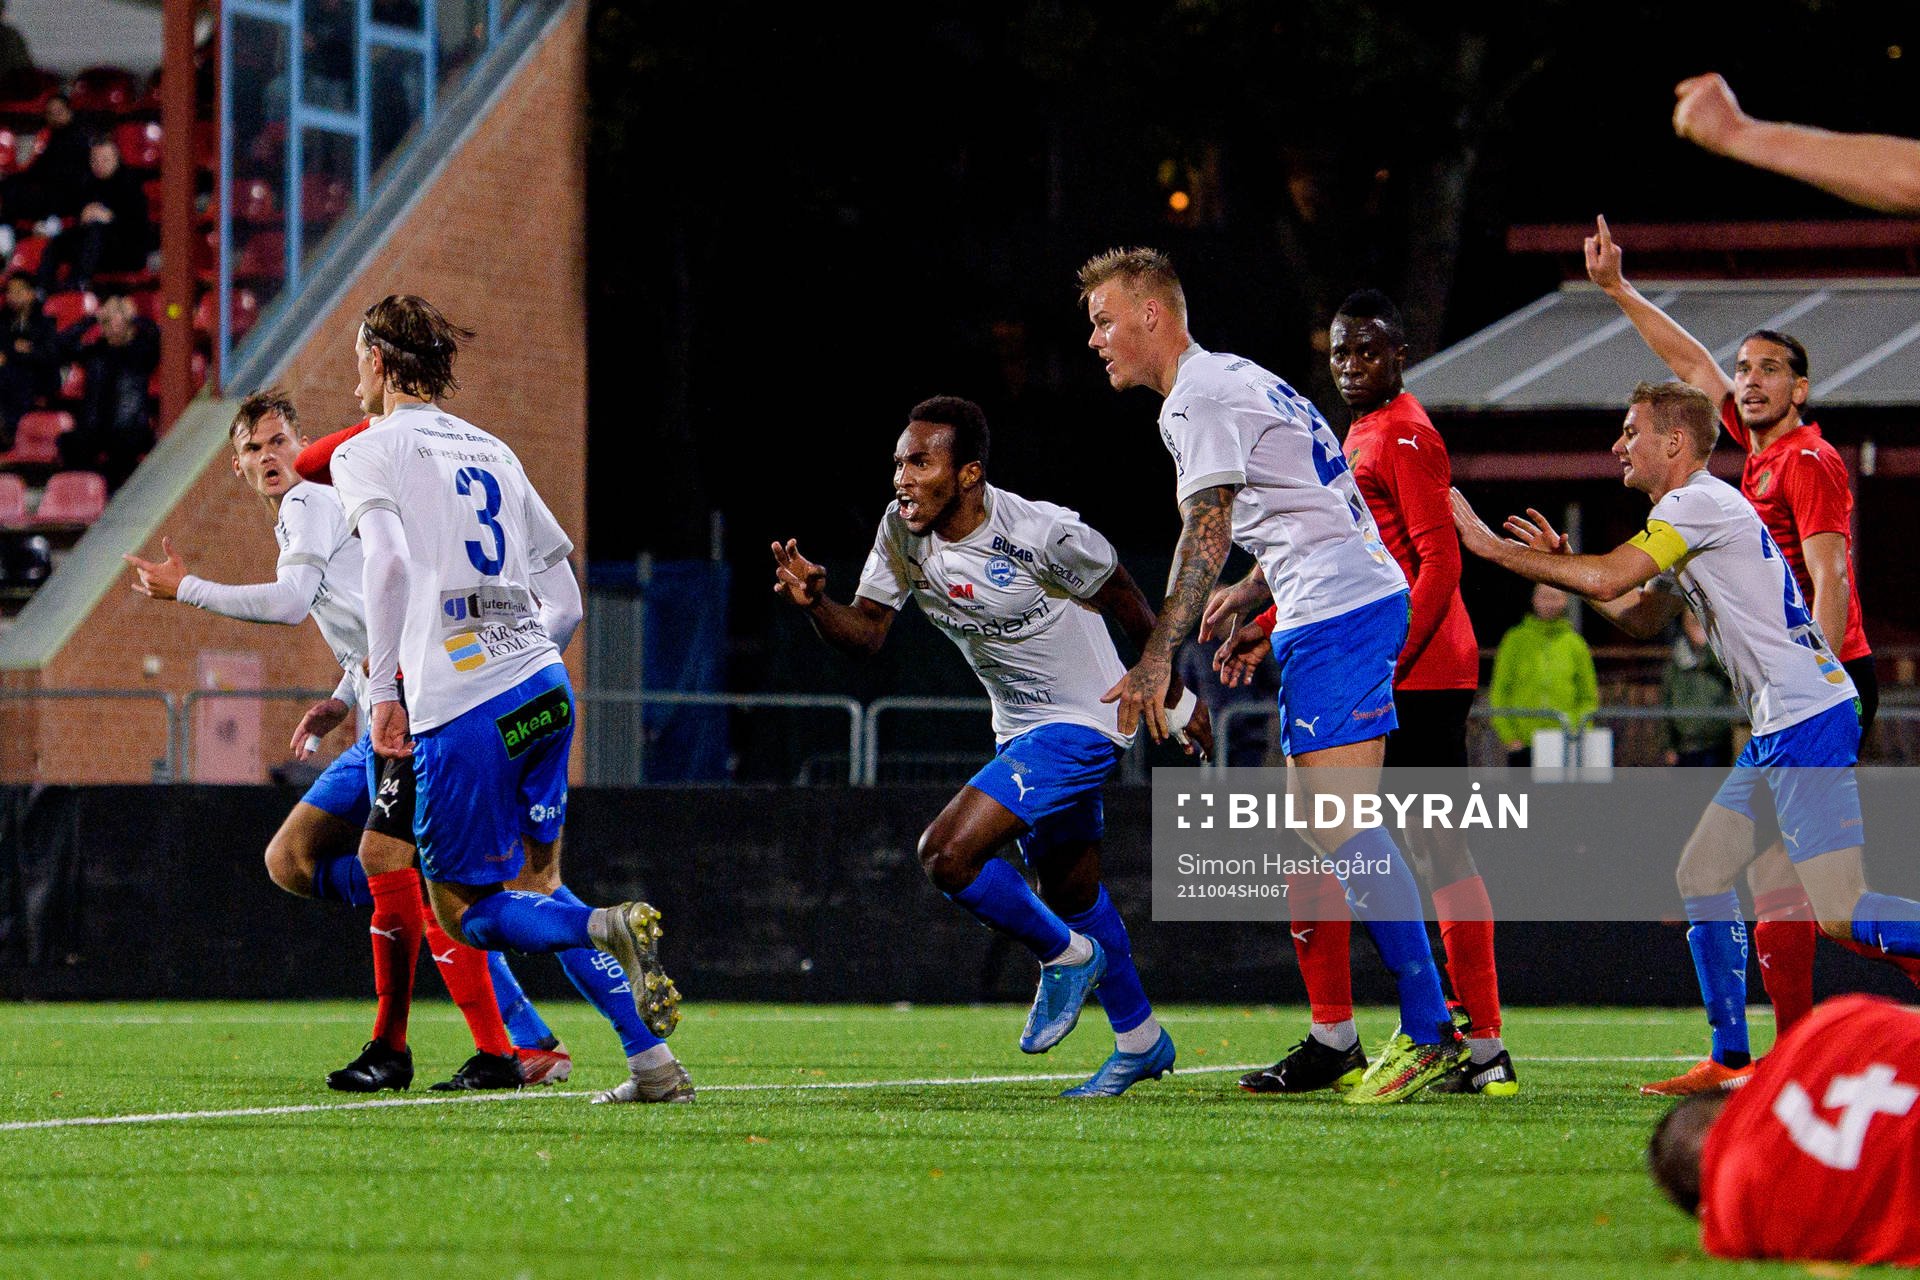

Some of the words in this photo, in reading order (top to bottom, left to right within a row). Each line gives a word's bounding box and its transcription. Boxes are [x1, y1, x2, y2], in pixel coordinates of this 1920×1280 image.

[456, 467, 505, 576] 3
[505, 710, 553, 747] akea
[380, 778, 400, 796] 24
